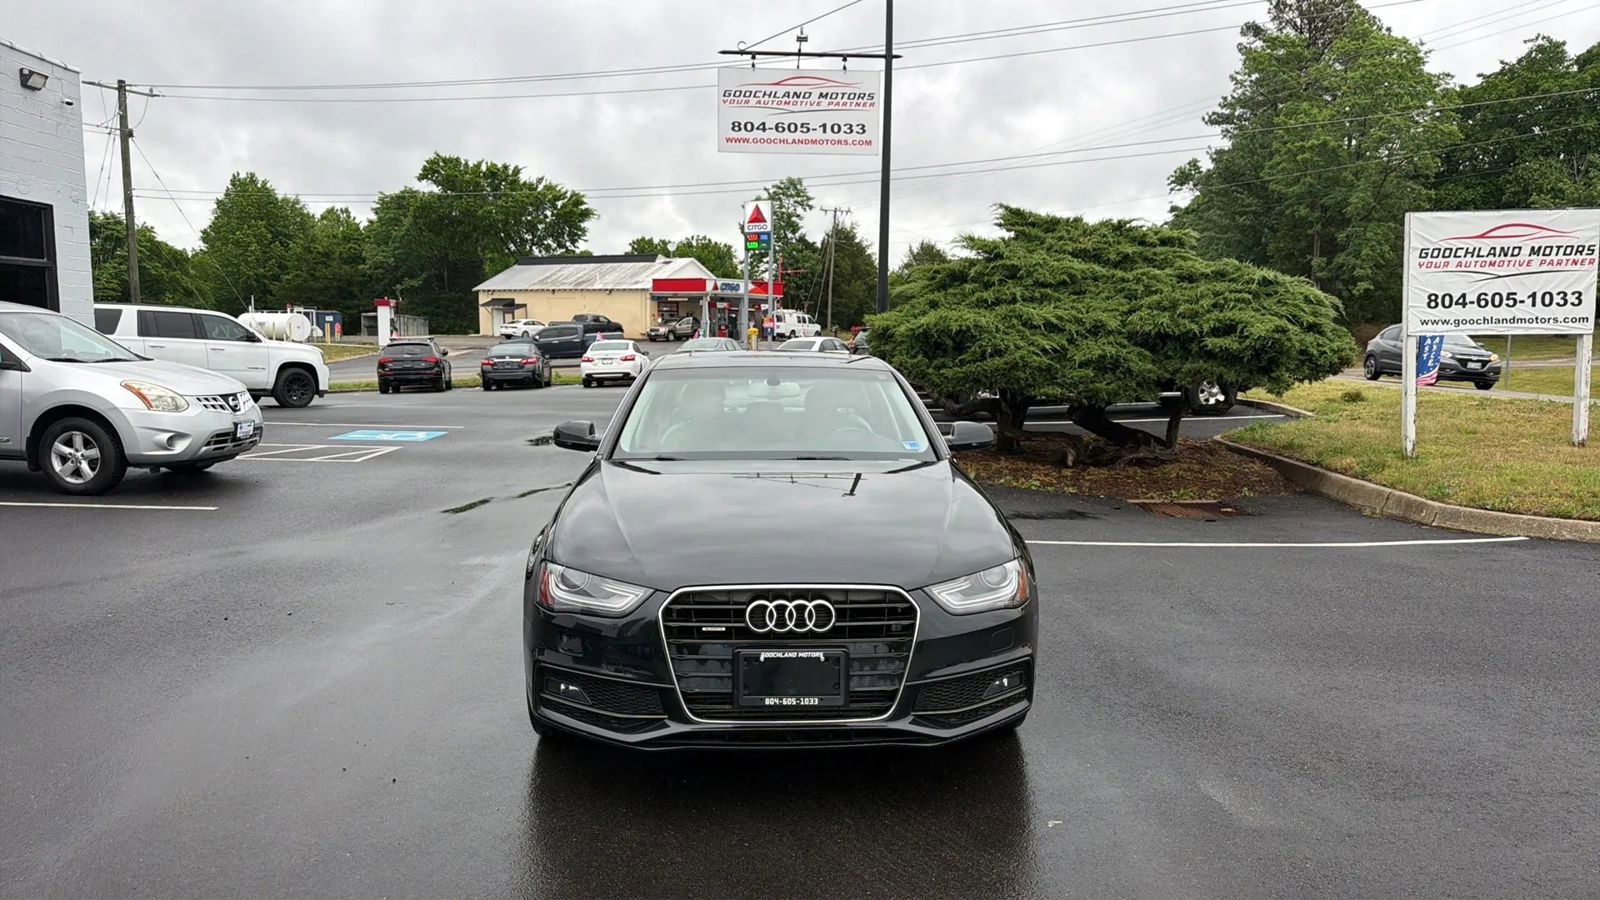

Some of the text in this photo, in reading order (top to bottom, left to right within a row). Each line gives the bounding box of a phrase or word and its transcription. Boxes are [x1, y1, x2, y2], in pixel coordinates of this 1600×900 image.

[723, 89, 875, 101] GOOCHLAND MOTORS
[755, 99, 822, 107] AUTOMOTIVE
[730, 121, 867, 135] 804-605-1033
[725, 137, 873, 146] WWW.GOOCHLANDMOTORS.COM
[1418, 244, 1597, 259] GOOCHLAND MOTORS
[1418, 258, 1596, 269] YOUR AUTOMOTIVE PARTNER
[1426, 291, 1583, 310] 804-605-1033
[1419, 315, 1589, 328] www.goochlandmotors.com
[765, 697, 819, 705] 804-605-1033
